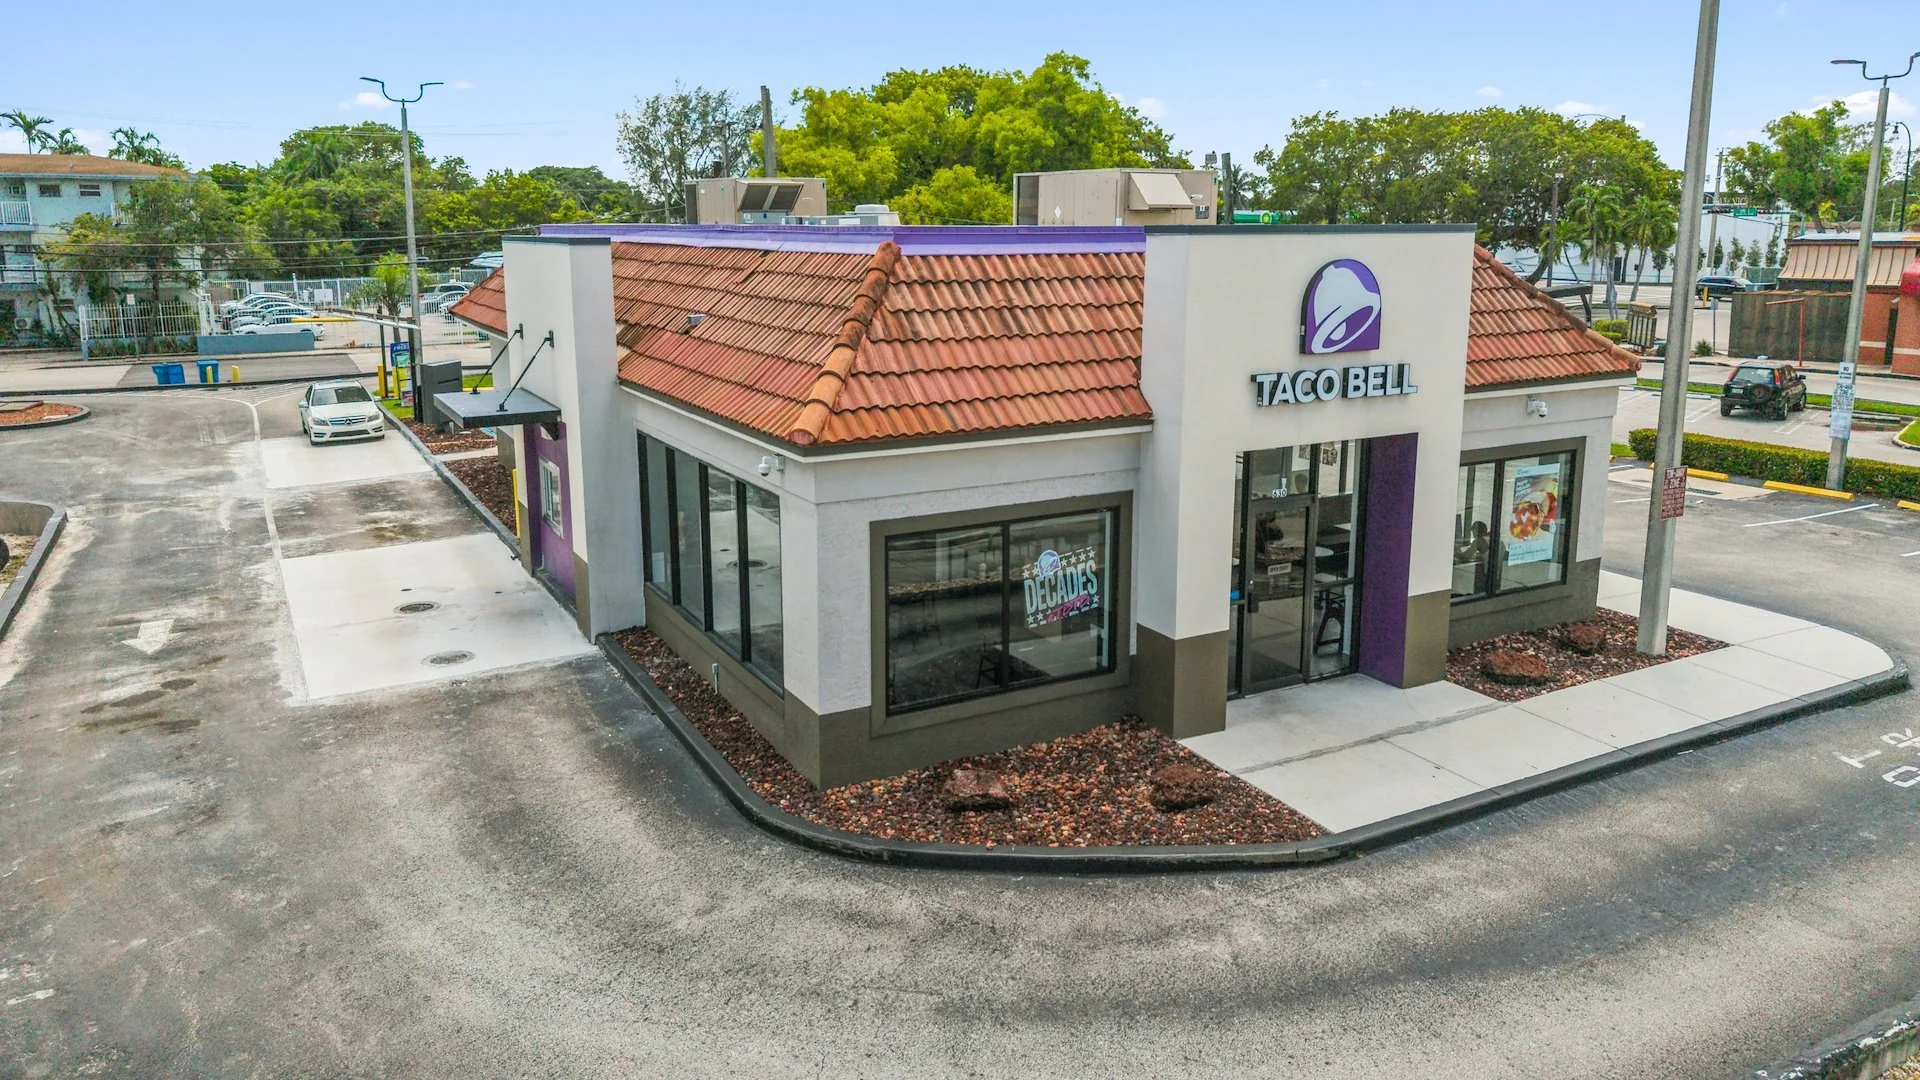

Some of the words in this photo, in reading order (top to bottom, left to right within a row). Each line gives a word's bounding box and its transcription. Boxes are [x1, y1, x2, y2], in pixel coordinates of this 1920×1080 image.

[1252, 369, 1341, 407] TACO
[1343, 363, 1418, 400] BELL
[1272, 489, 1287, 499] 630
[1024, 560, 1098, 614] DECADES
